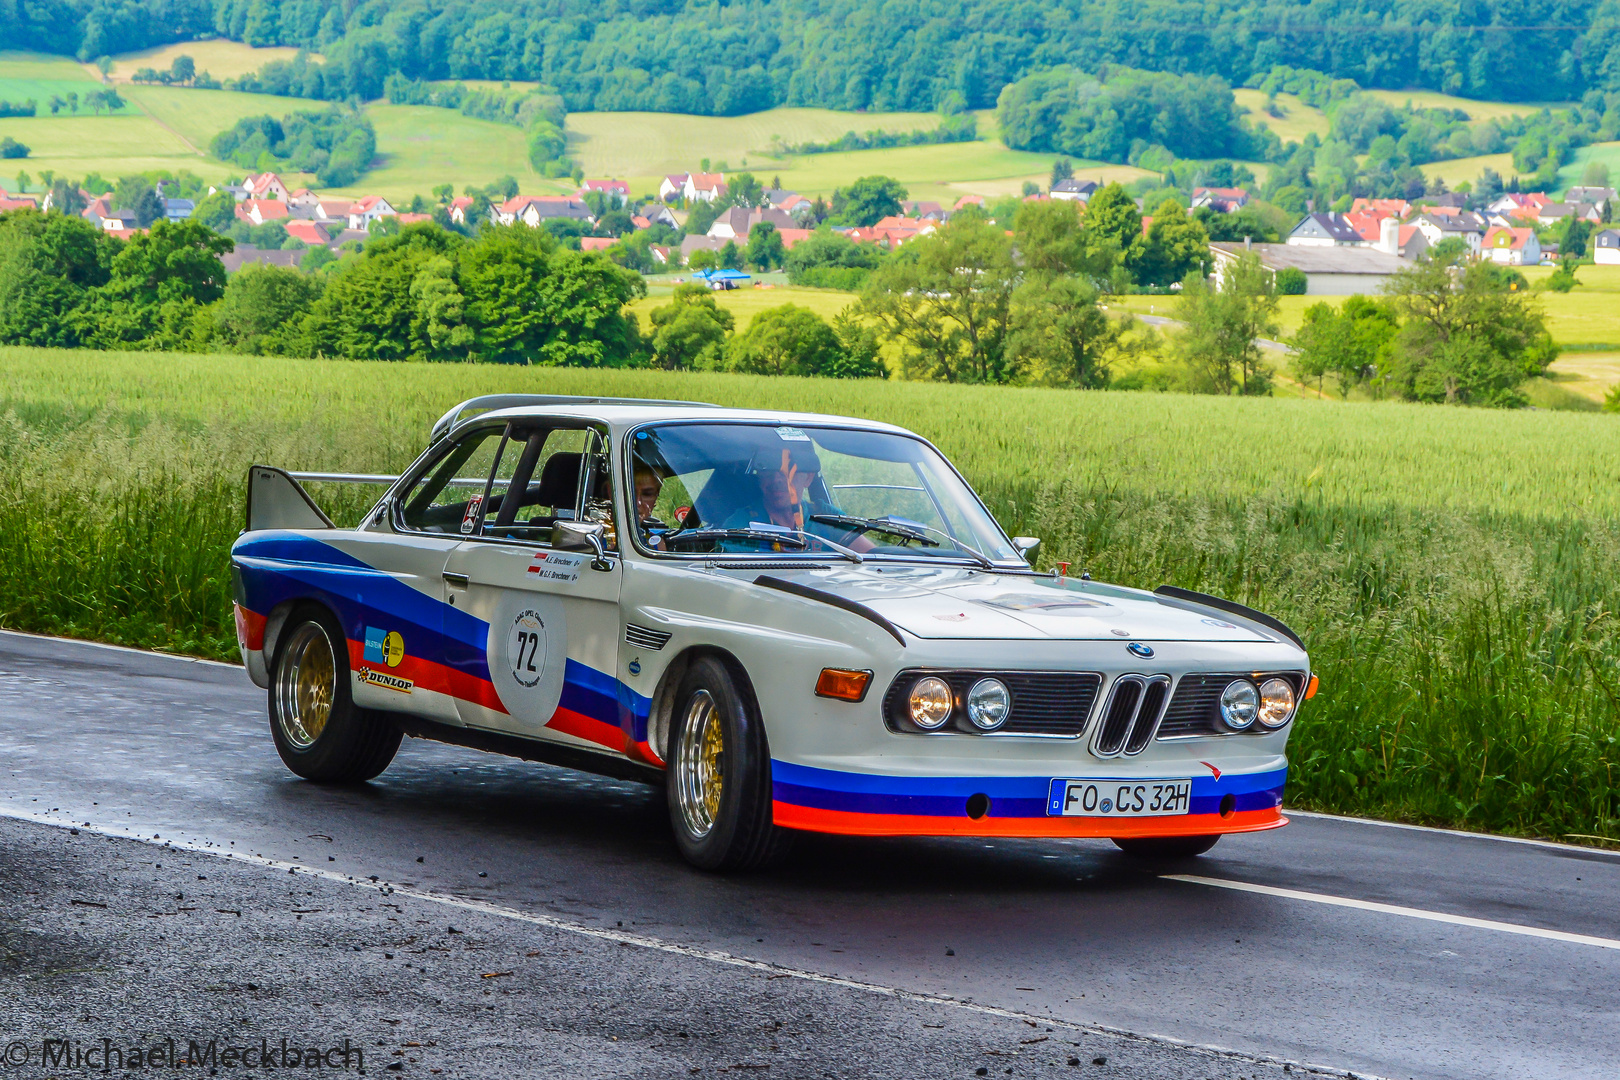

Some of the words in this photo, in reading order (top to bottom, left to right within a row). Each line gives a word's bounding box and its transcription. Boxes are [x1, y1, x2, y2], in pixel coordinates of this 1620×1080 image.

[365, 639, 382, 649] BILSTEIN
[517, 631, 538, 672] 72
[369, 673, 411, 689] DUNLOP
[1052, 800, 1060, 809] D
[1064, 784, 1099, 812] FO
[1115, 785, 1146, 812] CS
[1149, 783, 1189, 811] 32H
